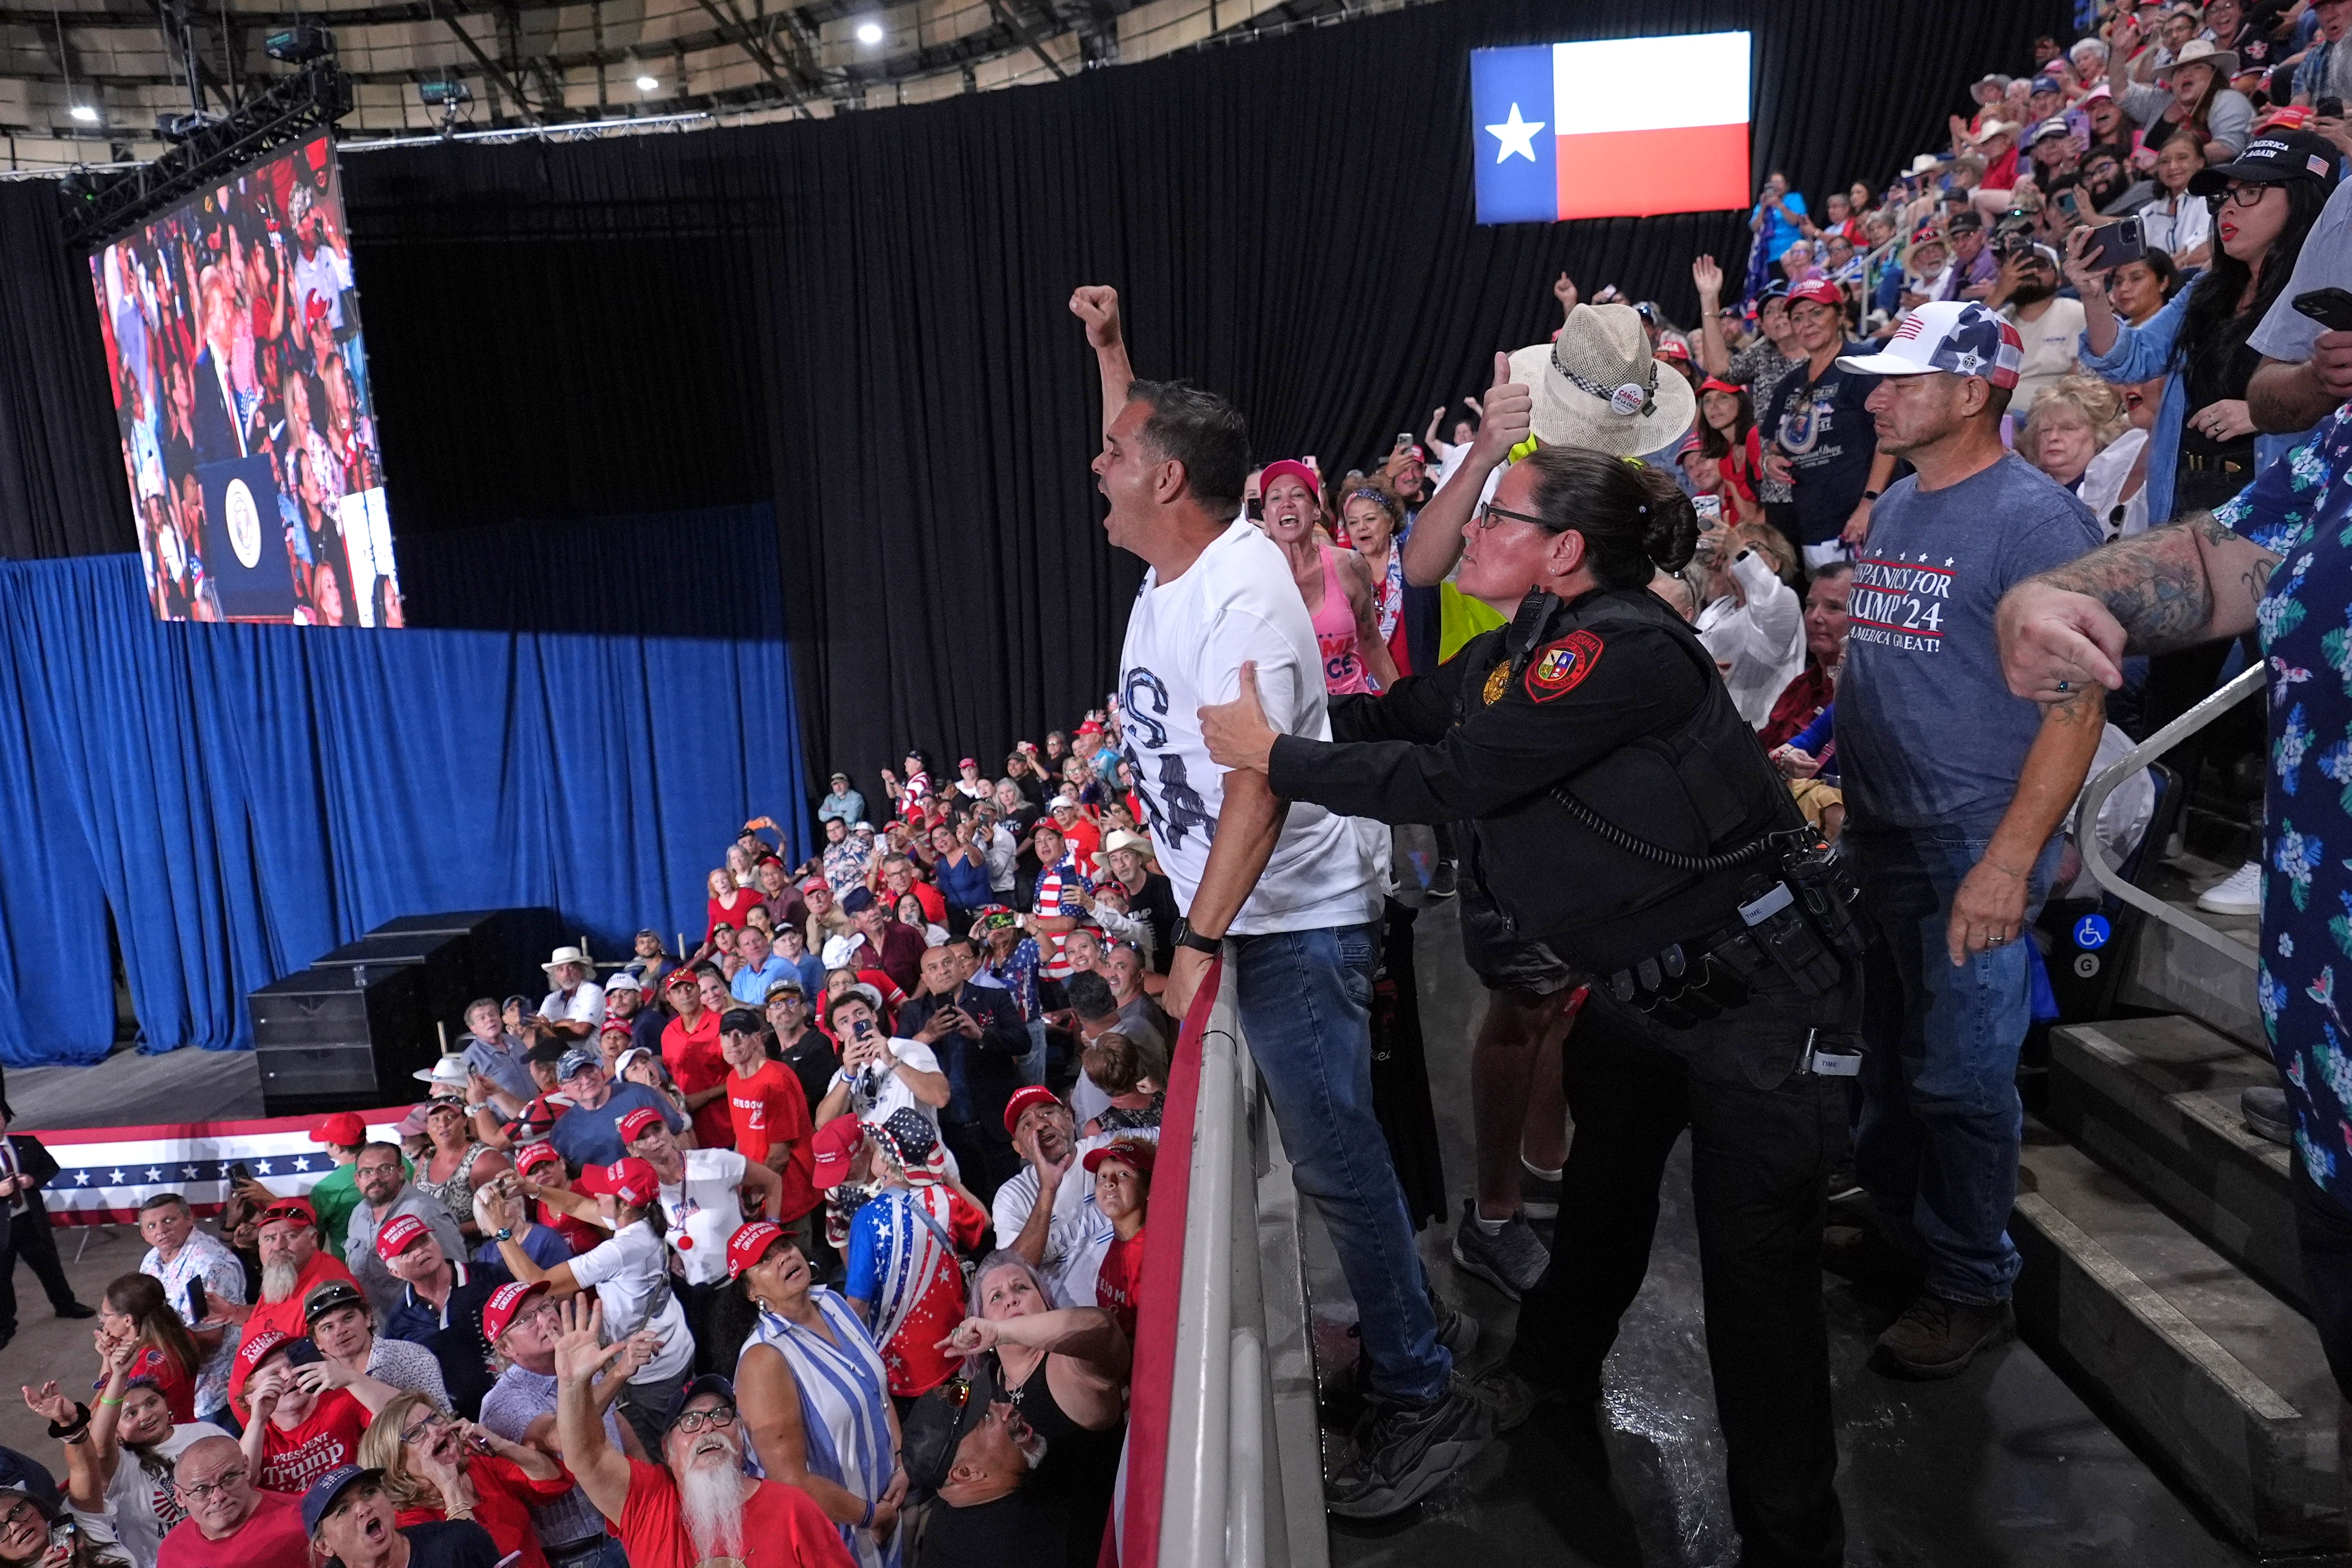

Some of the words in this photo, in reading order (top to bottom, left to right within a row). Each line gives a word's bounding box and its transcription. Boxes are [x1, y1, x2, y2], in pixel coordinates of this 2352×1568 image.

[2245, 149, 2277, 158] AGAIN
[1619, 390, 1642, 405] CARLOS
[1907, 571, 1951, 599] FOR
[1845, 587, 1901, 624] RUMP
[1848, 625, 1891, 646] AMERICA
[1893, 633, 1940, 653] GREAT!
[1746, 907, 1763, 919] TIME:
[2081, 959, 2092, 972] G
[382, 1225, 398, 1240] MAKE
[388, 1227, 407, 1245] GREAT
[732, 1230, 750, 1249] MAKE
[741, 1231, 760, 1251] GREAT
[490, 1290, 507, 1309] MAKE
[498, 1289, 517, 1311] GREAT
[241, 1331, 270, 1356] GULF
[263, 1442, 345, 1485] Trump
